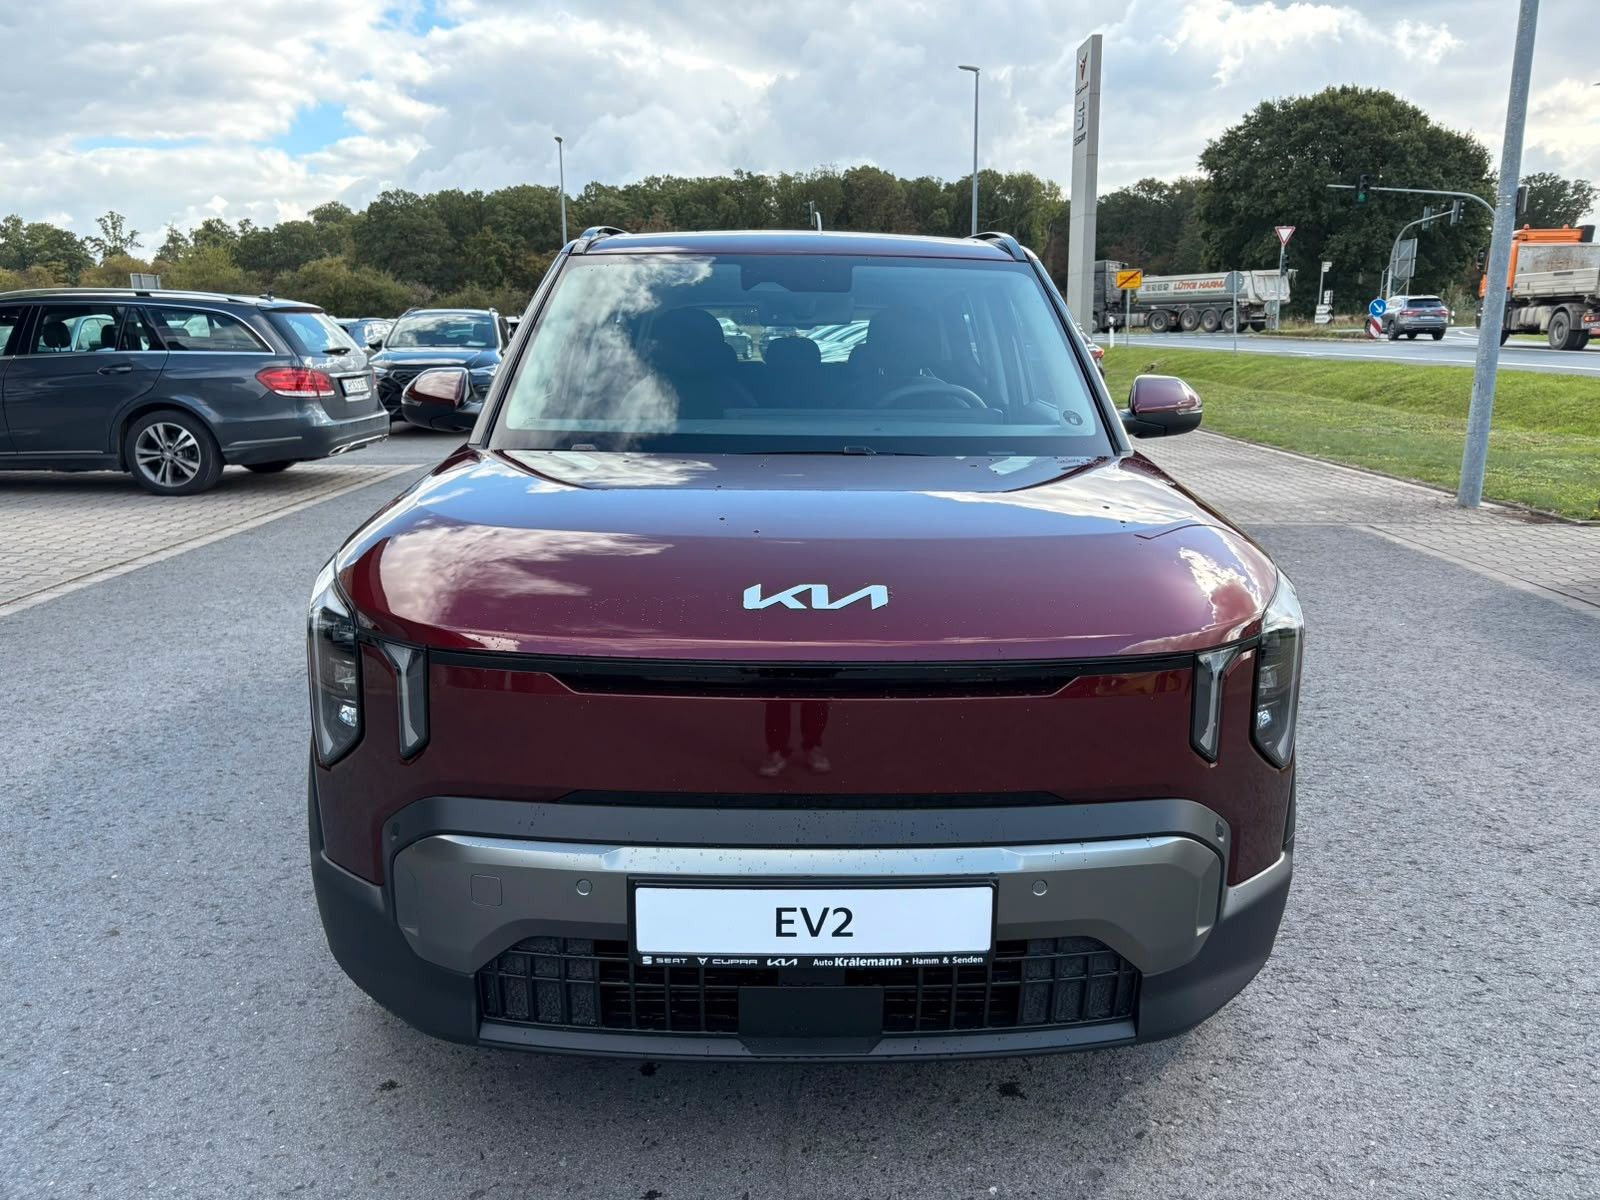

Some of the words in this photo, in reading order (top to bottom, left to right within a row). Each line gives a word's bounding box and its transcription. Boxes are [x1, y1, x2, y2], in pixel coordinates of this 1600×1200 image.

[743, 583, 889, 610] KIA
[775, 907, 854, 938] EV2
[711, 958, 758, 966] CUPRA
[766, 958, 798, 967] KIA
[812, 958, 834, 967] Auto
[912, 957, 939, 965] Hamm
[942, 956, 949, 965] &
[952, 955, 984, 964] Senden
